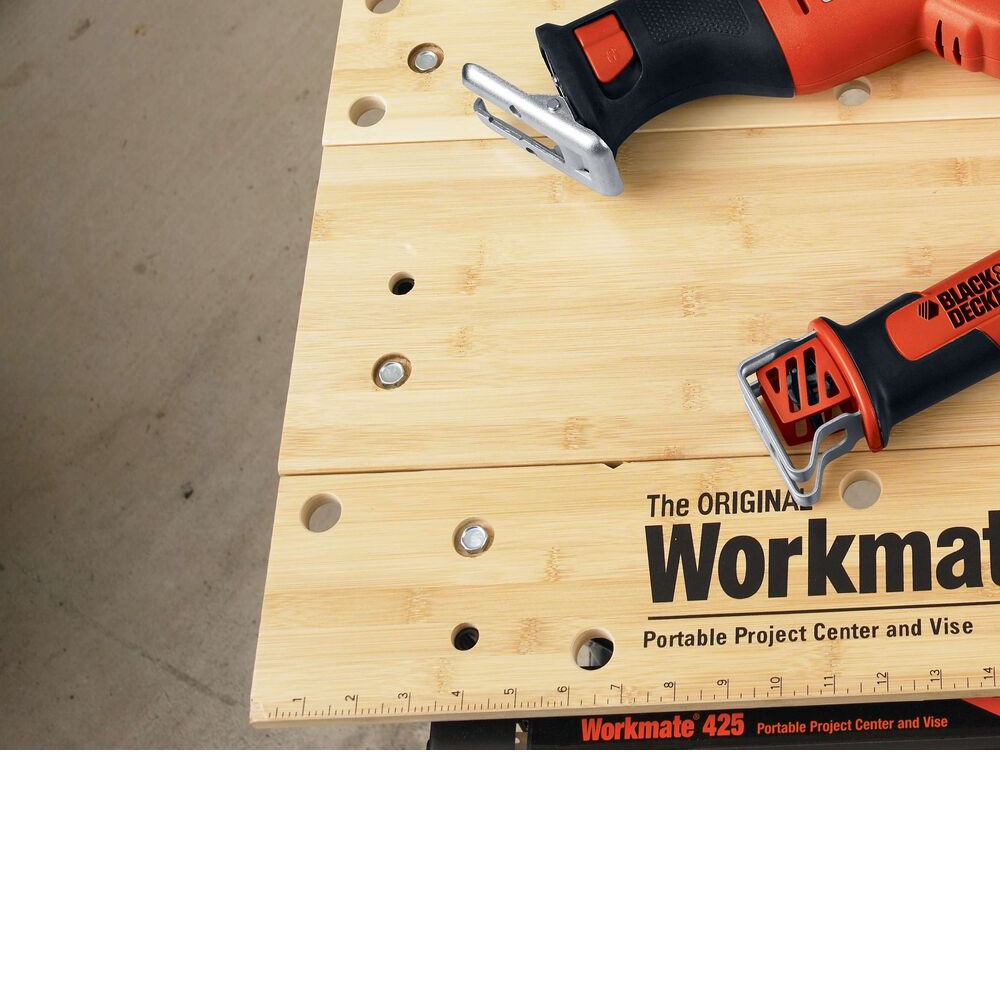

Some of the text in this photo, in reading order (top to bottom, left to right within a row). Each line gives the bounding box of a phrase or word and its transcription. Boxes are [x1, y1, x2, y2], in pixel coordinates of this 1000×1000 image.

[647, 494, 690, 517] The
[643, 616, 974, 648] Portable Project Center and Vise
[770, 676, 781, 690] 10
[823, 675, 833, 688] 11
[877, 672, 887, 685] 12
[930, 670, 941, 683] 13
[984, 667, 994, 680] 14
[702, 713, 745, 737] 425
[756, 720, 806, 735] Portable
[809, 719, 852, 734] Project
[855, 717, 895, 731] Center
[897, 717, 920, 730] and
[922, 716, 948, 728] Vise
